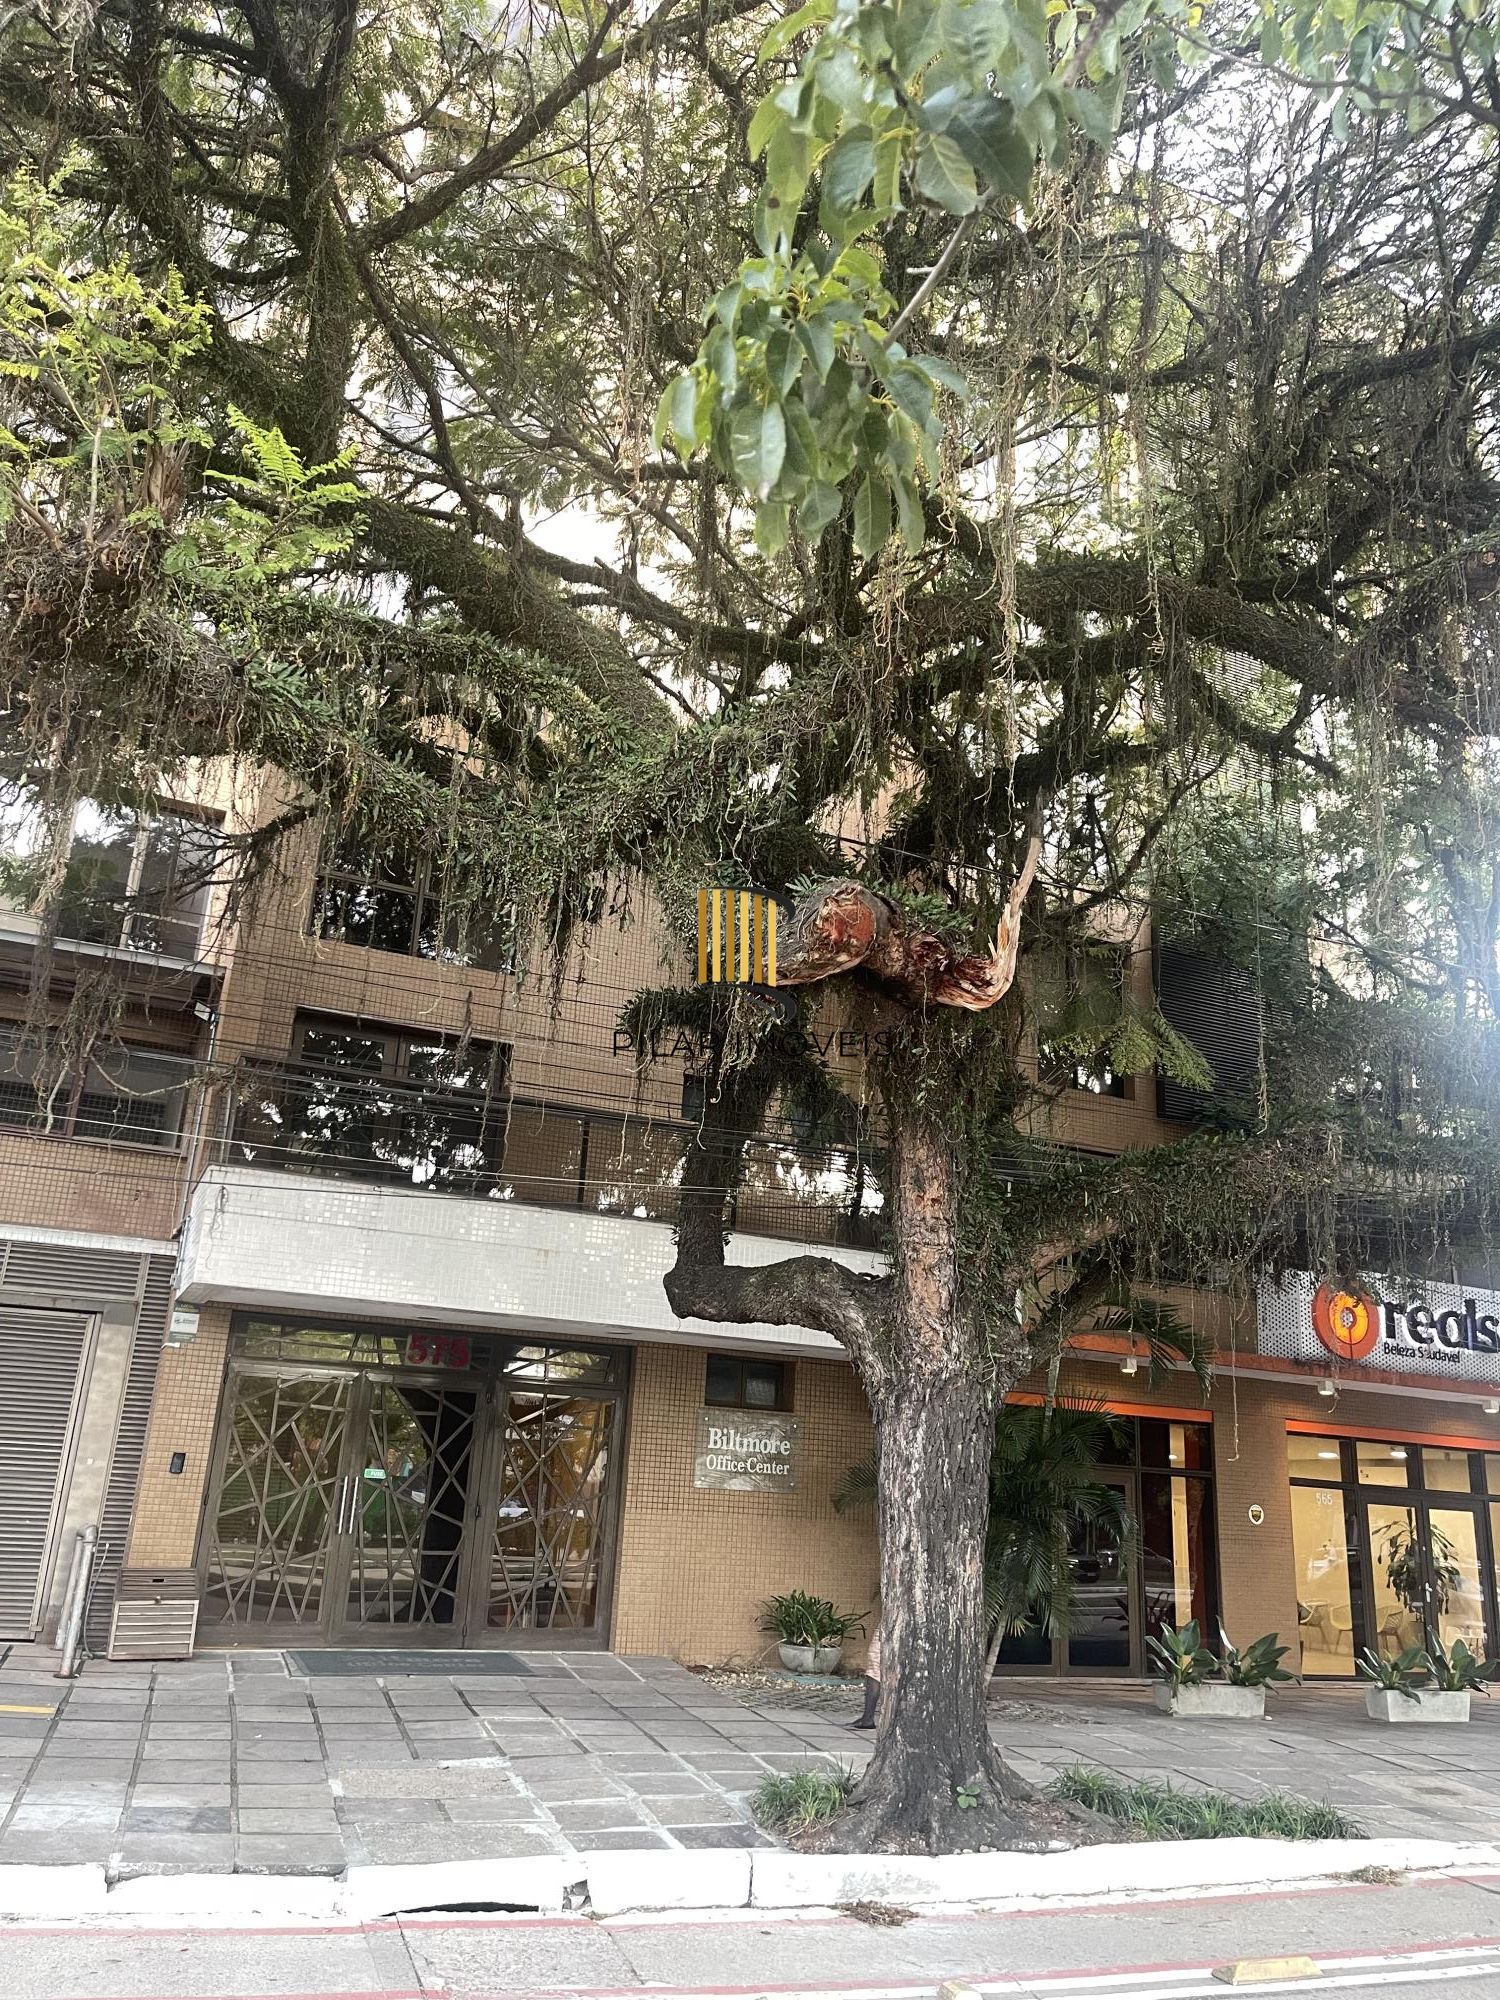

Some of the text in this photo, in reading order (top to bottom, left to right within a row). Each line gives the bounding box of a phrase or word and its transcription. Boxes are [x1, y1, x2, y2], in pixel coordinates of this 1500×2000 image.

[407, 1333, 470, 1368] 575
[1384, 1341, 1415, 1358] Beleza
[708, 1427, 791, 1456] Biltmore
[706, 1453, 790, 1475] Office Center
